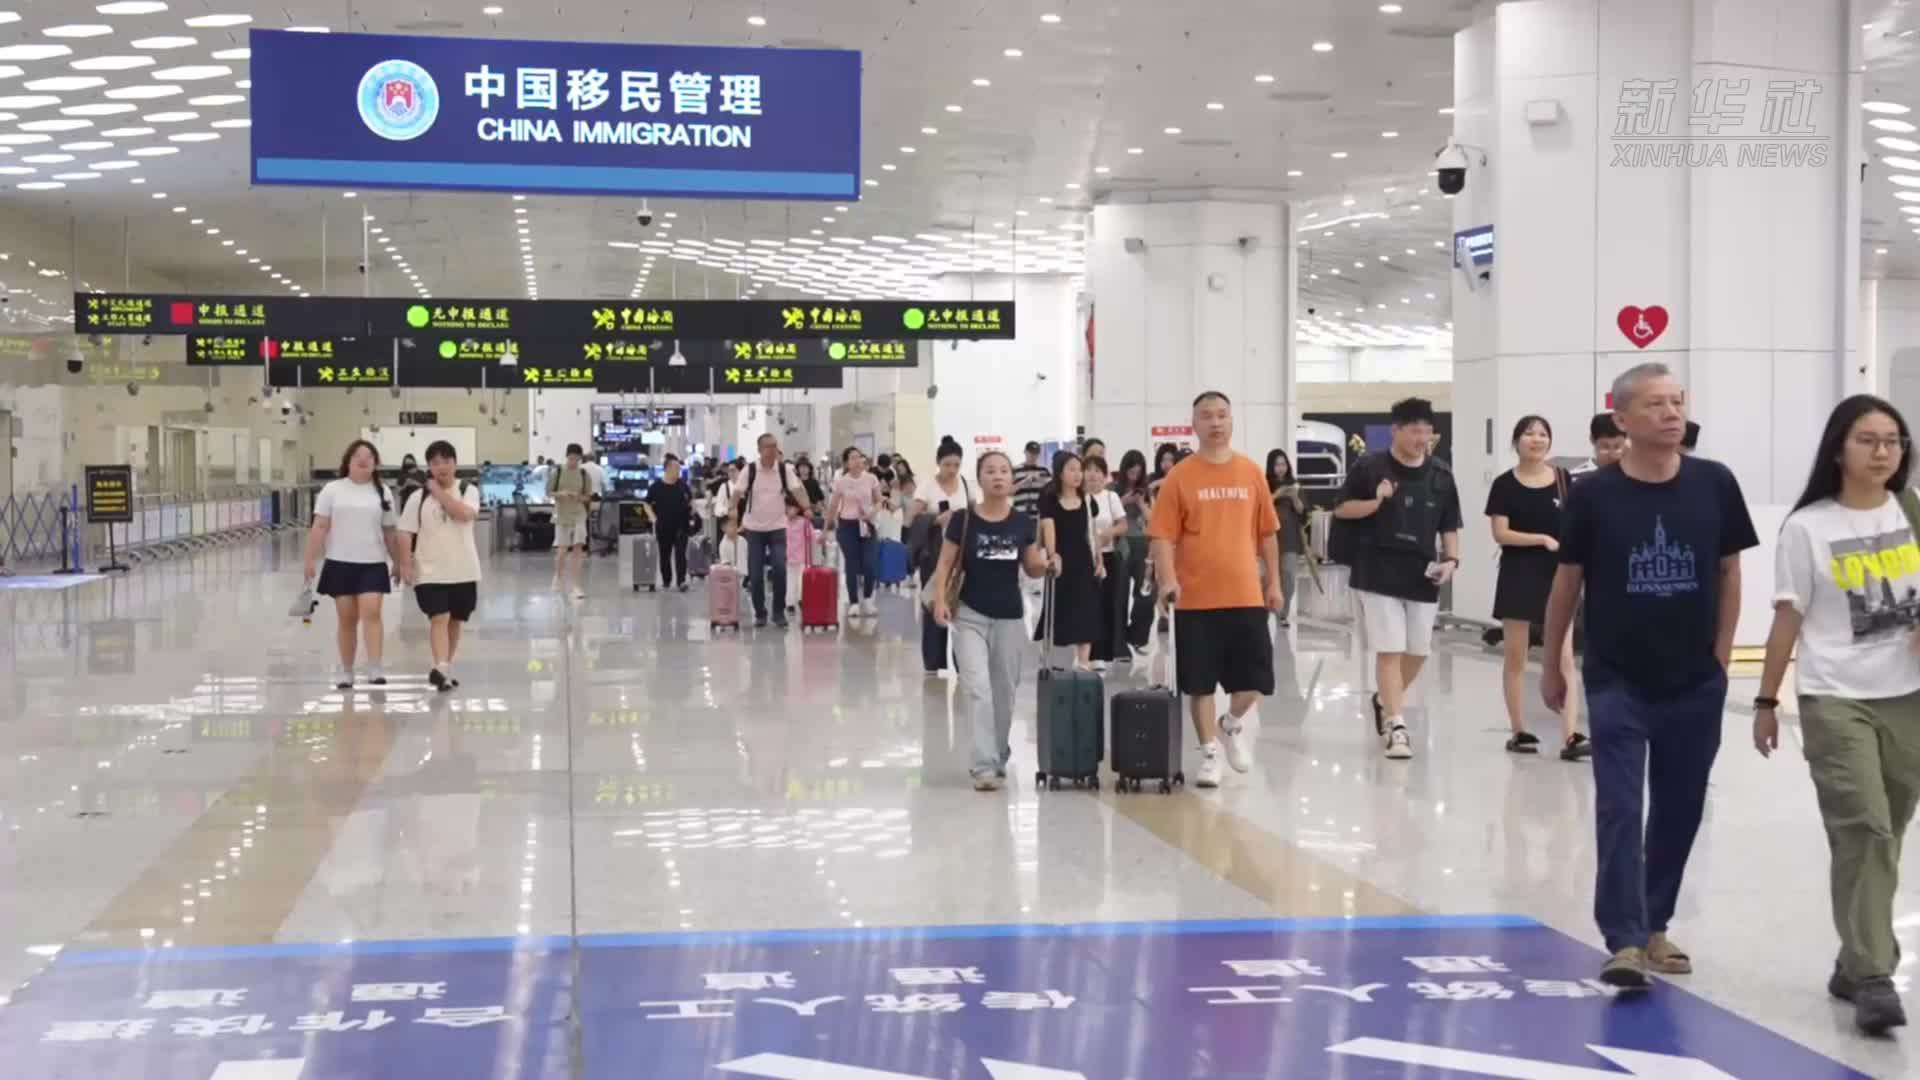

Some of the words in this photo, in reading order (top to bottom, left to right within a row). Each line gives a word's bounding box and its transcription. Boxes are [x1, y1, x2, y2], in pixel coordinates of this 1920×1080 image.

[463, 65, 764, 117] 中国移民管理
[477, 117, 562, 144] CHINA
[573, 119, 752, 149] IMMIGRATION
[639, 989, 1077, 1020] 传统人工
